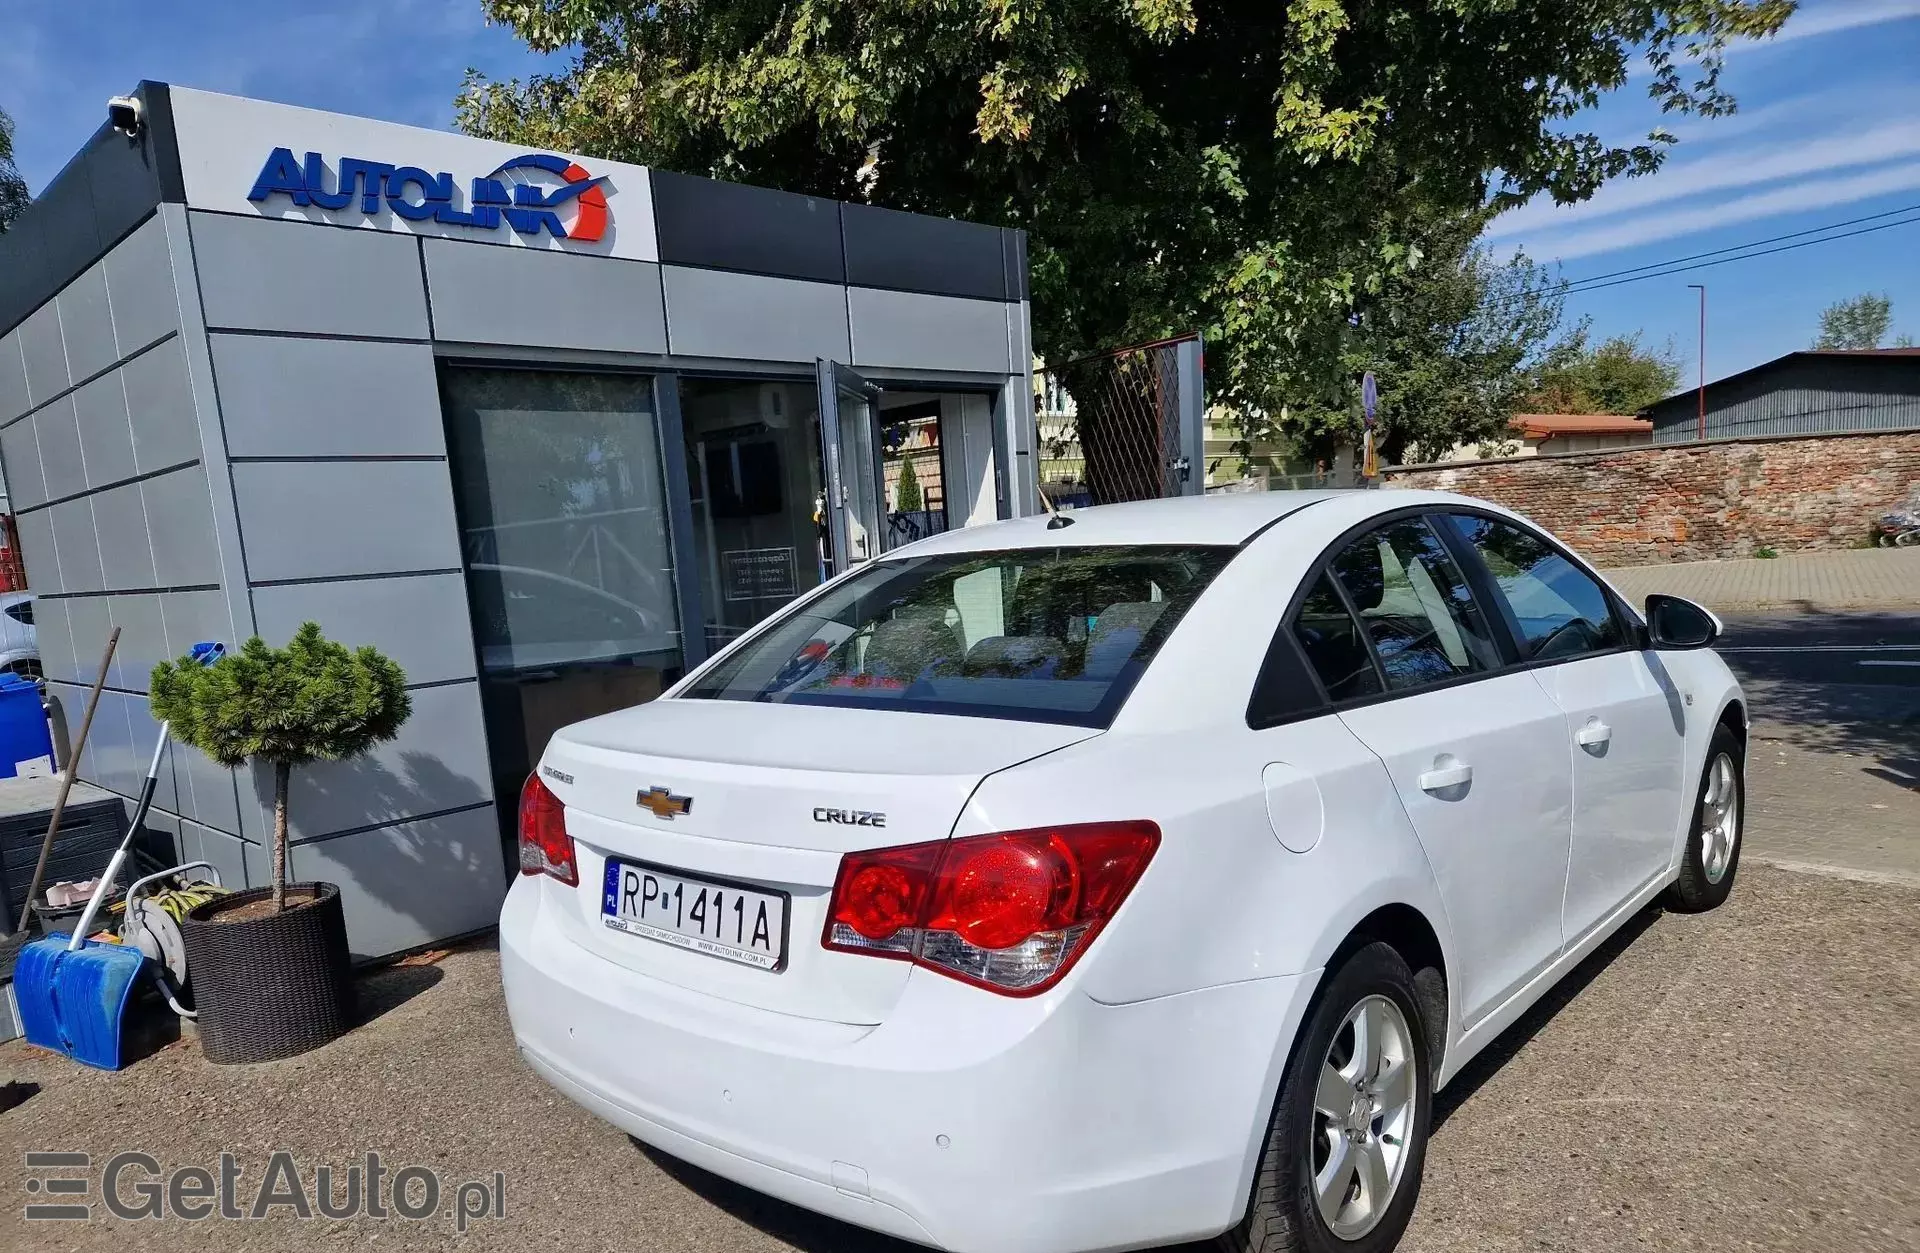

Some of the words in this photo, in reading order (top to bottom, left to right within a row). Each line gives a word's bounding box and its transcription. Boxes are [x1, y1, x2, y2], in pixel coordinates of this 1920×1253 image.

[247, 147, 607, 241] AUTOLINK
[813, 807, 887, 828] CRUZE
[606, 894, 617, 908] PL
[623, 870, 659, 918] RP
[674, 882, 770, 951] 1411A
